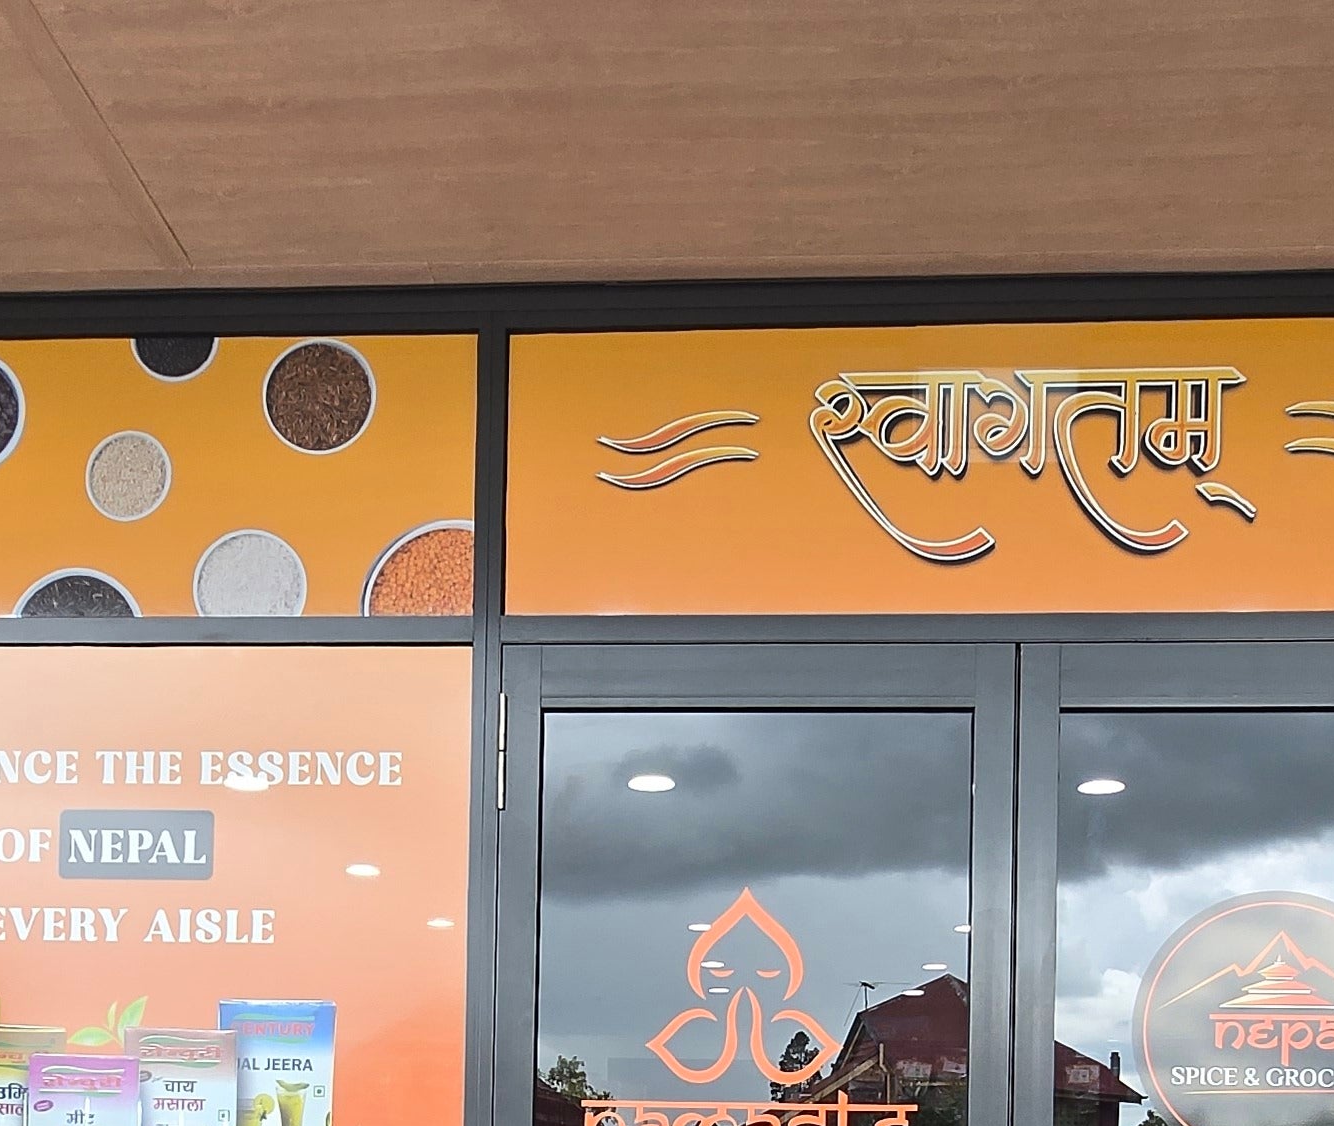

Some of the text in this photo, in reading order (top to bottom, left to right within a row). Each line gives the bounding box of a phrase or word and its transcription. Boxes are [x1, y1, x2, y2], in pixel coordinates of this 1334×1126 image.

[96, 750, 182, 786] THE
[200, 750, 404, 788] ESSENCE
[66, 829, 207, 865] NEPAL
[143, 908, 276, 944] AISLE
[264, 1058, 314, 1072] JEERA
[163, 1079, 198, 1094] चाय
[1170, 1066, 1238, 1087] SPICE
[1244, 1067, 1260, 1087] &
[152, 1098, 206, 1113] मसाला
